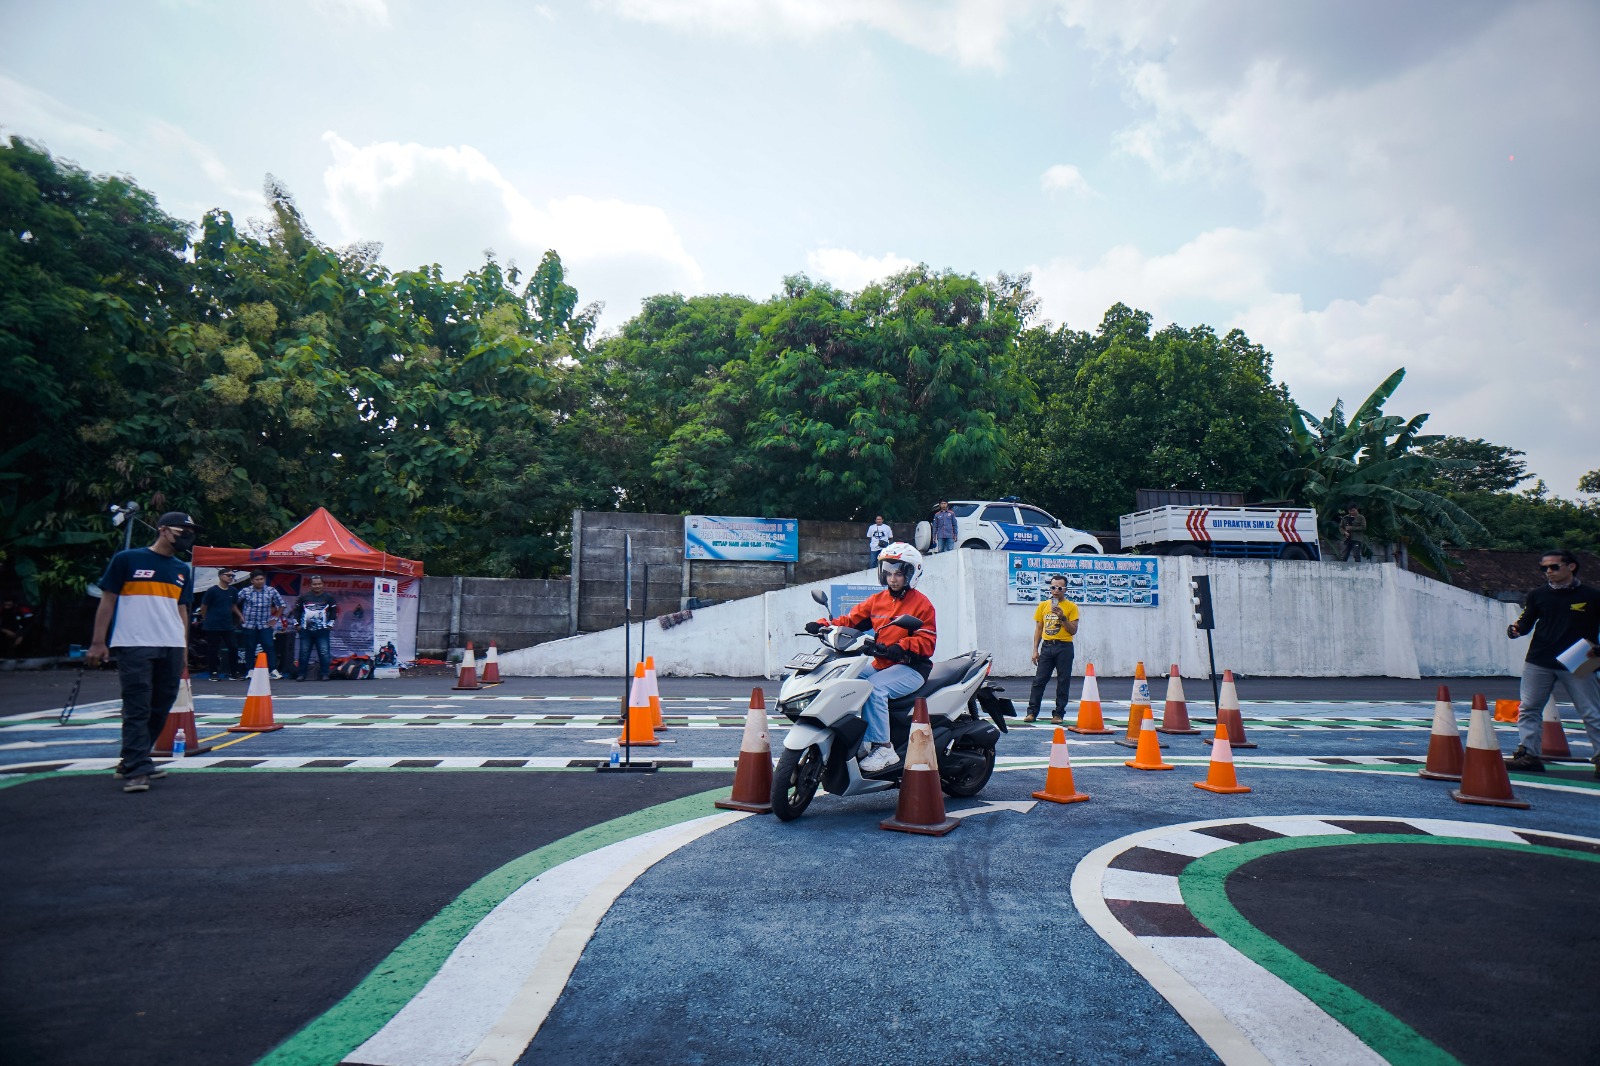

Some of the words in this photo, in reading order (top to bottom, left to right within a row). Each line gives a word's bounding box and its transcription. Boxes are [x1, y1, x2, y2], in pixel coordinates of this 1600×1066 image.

[1212, 519, 1222, 528] UJI
[1223, 519, 1251, 529] PRAKTEK
[1252, 520, 1264, 529] SIM
[1265, 520, 1274, 529] B2
[1027, 557, 1041, 568] UJI
[1041, 557, 1078, 569] PRAKTEK
[1078, 559, 1093, 570] SIM
[1094, 559, 1115, 571] RODA
[1116, 560, 1141, 571] EMPAT
[133, 569, 155, 578] 93
[302, 578, 348, 588] Krnia
